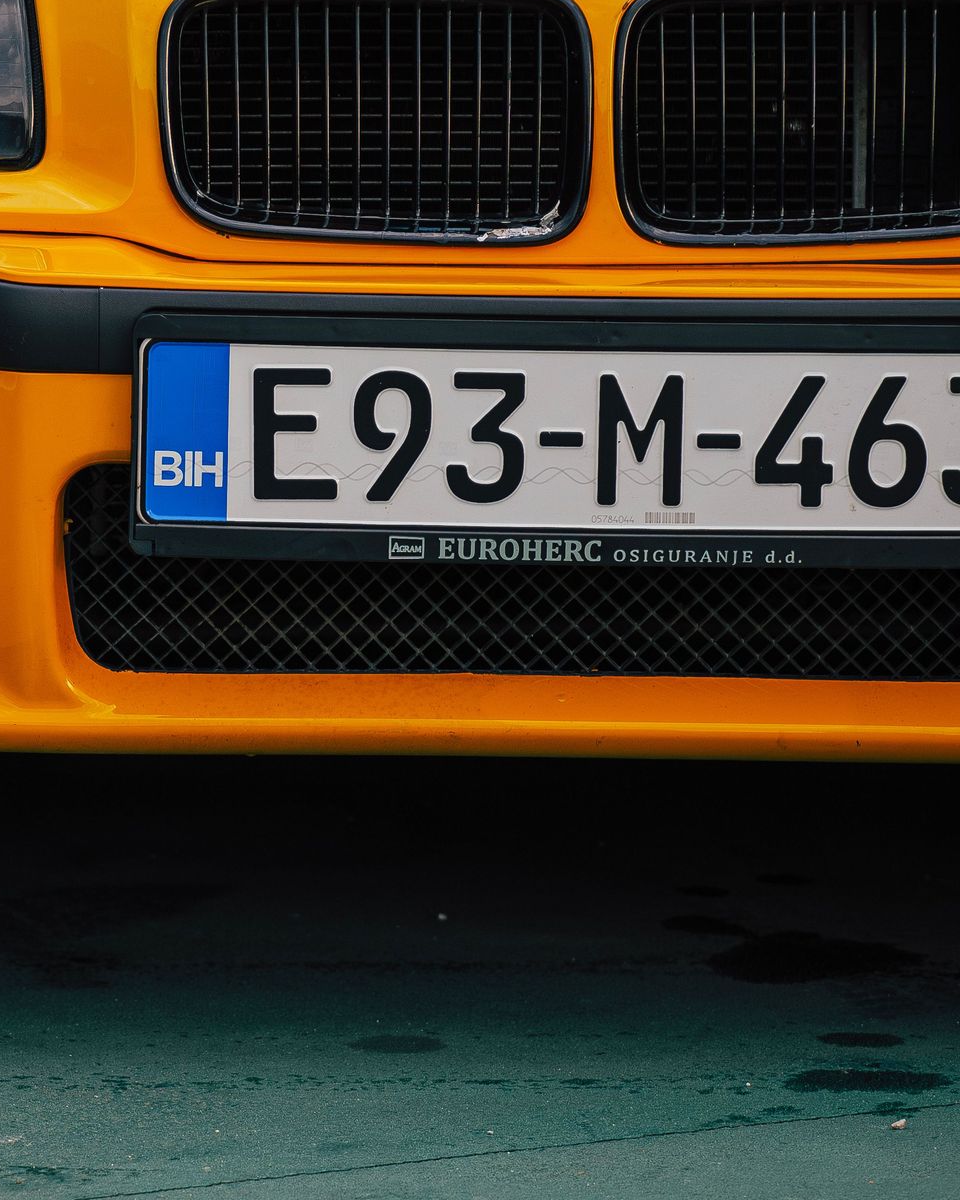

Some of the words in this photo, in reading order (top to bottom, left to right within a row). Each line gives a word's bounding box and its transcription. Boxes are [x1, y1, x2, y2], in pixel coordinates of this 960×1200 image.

[152, 450, 224, 488] BIH
[591, 514, 635, 524] 05784044
[437, 537, 602, 562] EUROHERC
[613, 549, 754, 565] OSIGURANJE
[765, 551, 803, 564] d.d.
